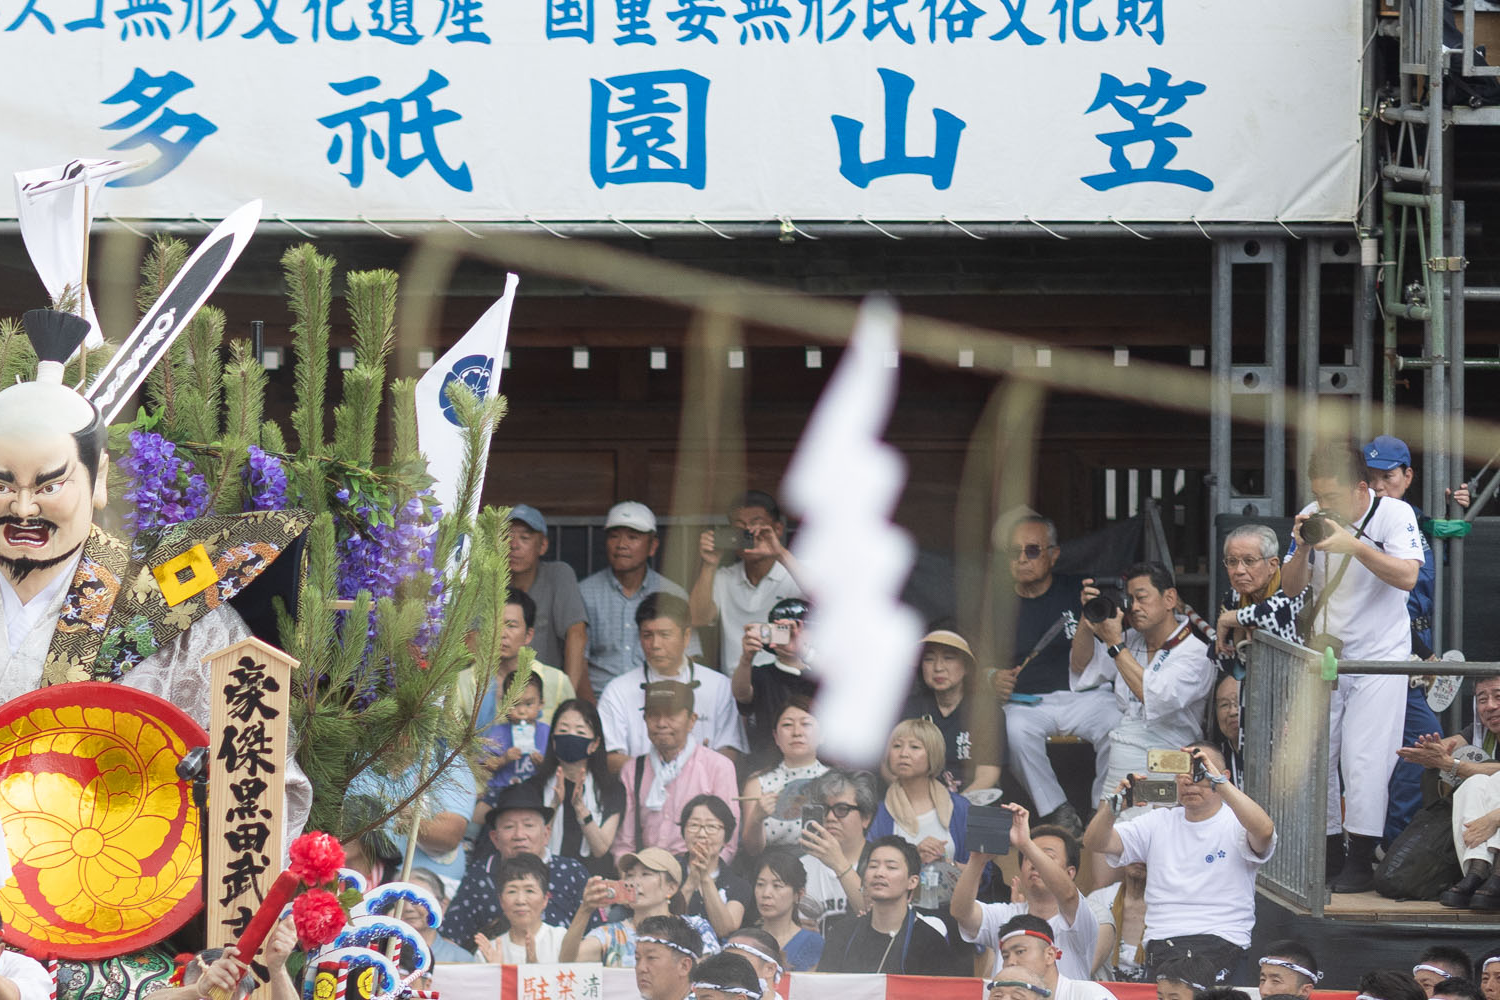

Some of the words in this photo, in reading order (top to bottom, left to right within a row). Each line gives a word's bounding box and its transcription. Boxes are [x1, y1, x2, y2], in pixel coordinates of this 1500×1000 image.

[545, 0, 1167, 46] 国重要無形民俗文化財
